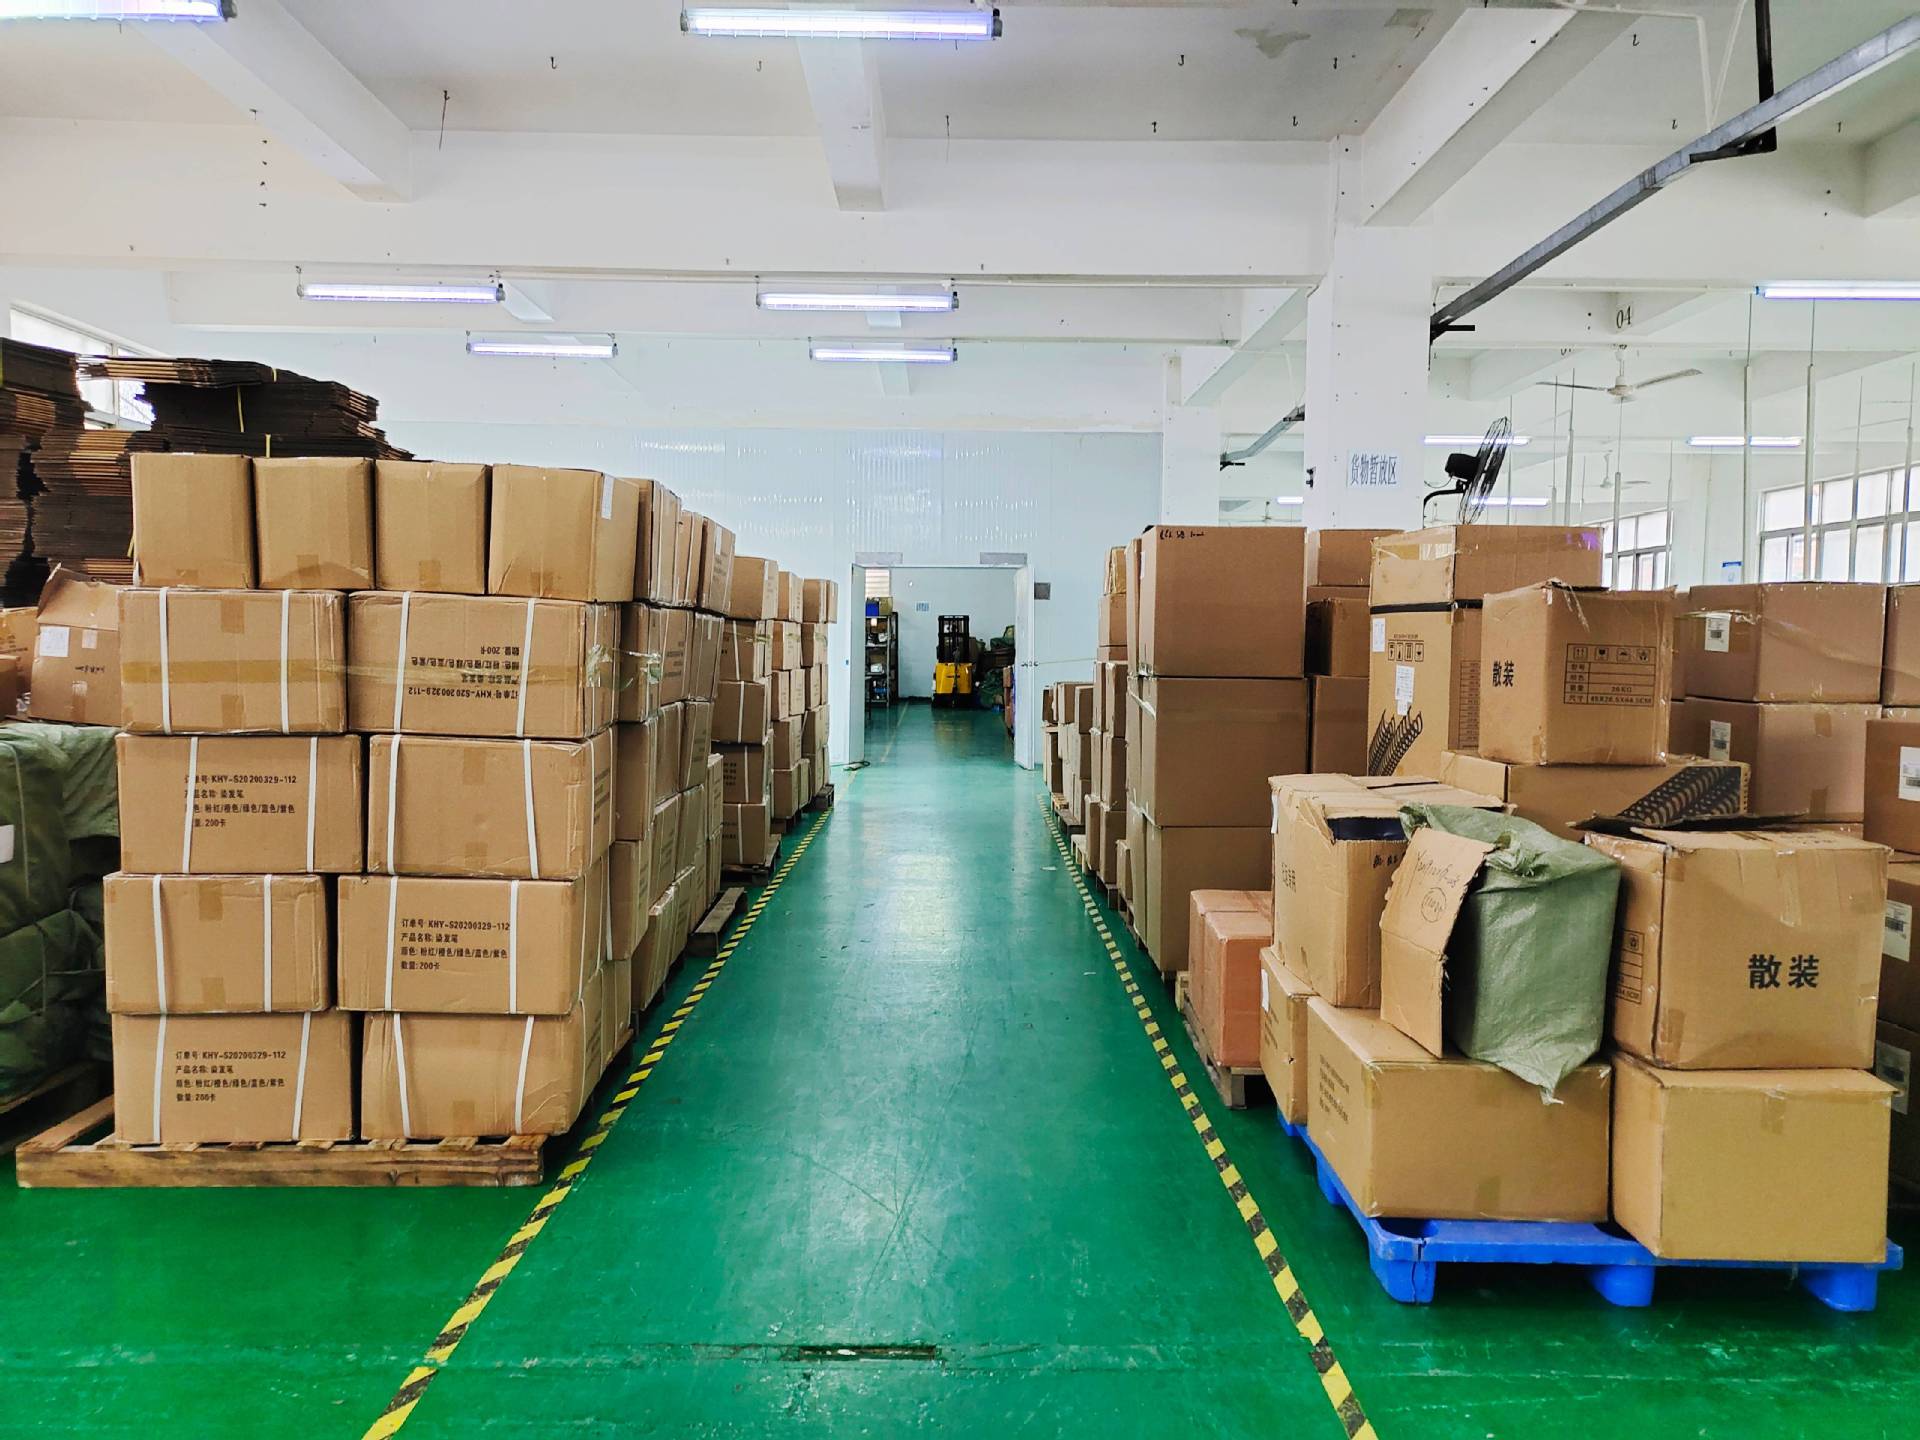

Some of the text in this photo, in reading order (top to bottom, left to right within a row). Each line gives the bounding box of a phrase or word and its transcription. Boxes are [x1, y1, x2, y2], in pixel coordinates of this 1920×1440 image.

[1616, 305, 1631, 329] 04
[1351, 453, 1397, 485] 货物暂放区
[1492, 659, 1515, 687] 散装
[428, 919, 510, 931] KHY-S20200329-112
[1748, 953, 1819, 989] 散装
